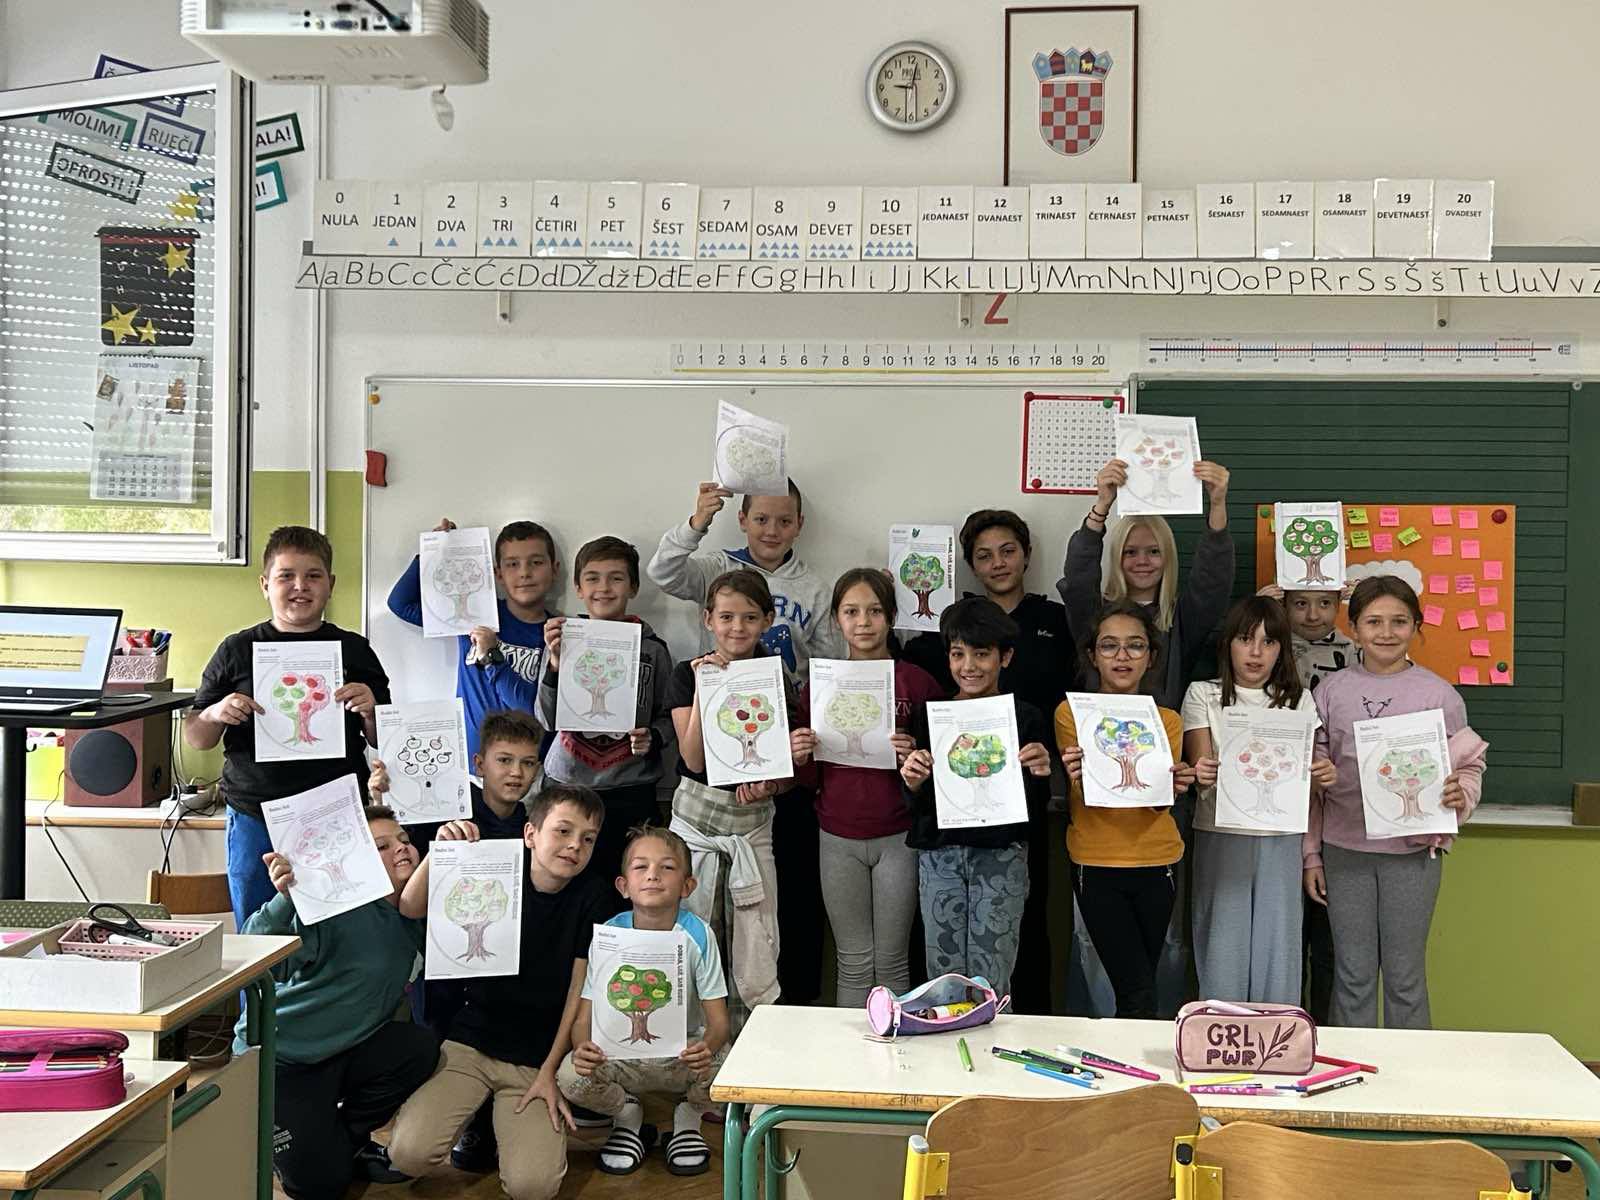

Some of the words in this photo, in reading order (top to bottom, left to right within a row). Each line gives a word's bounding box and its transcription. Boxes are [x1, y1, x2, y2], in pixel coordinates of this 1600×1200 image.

[895, 60, 901, 68] 11
[908, 56, 916, 64] 12
[925, 60, 928, 68] 1
[884, 71, 893, 79] 10
[935, 70, 939, 78] 2
[939, 83, 943, 91] 3
[883, 99, 888, 107] 8
[896, 108, 900, 116] 7
[909, 112, 914, 120] 6
[58, 109, 122, 140] MOLIM!
[256, 126, 292, 147] ALA!
[336, 192, 344, 203] 0
[394, 194, 400, 205] 1
[447, 196, 455, 208] 2
[500, 196, 508, 208] 3
[550, 195, 560, 208] 4
[608, 197, 615, 209] 5
[940, 198, 952, 206] 11
[1050, 196, 1062, 205] 13
[1106, 197, 1118, 205] 14
[1220, 195, 1233, 204] 16
[1280, 194, 1292, 203] 17
[1338, 194, 1351, 203] 18
[1397, 194, 1411, 203] 19
[1458, 194, 1471, 203] 20
[662, 198, 670, 211] 6
[723, 200, 730, 211] 7
[774, 201, 784, 214] 8
[828, 201, 835, 212] 9
[882, 200, 900, 213] 10
[994, 199, 1006, 208] 12
[1161, 200, 1174, 208] 15
[922, 213, 968, 221] JEDANAEST
[1036, 212, 1076, 220] TRINAEST
[1088, 212, 1136, 220] ČETRNAEST
[1208, 210, 1244, 218] ŠESNAEST
[1377, 211, 1429, 219] DEVETNAEST
[322, 214, 359, 226] NULA
[373, 216, 416, 228] JEDAN
[536, 217, 577, 232] ČETIRI
[438, 220, 466, 232] DVA
[493, 220, 512, 232] TRI
[601, 220, 624, 232] PET
[653, 219, 684, 234] ŠEST
[699, 221, 748, 233] SEDAM
[756, 224, 798, 236] OSAM
[810, 224, 852, 236] DEVET
[871, 224, 912, 236] DESET
[677, 355, 684, 366] 0
[698, 355, 703, 365] 1
[718, 355, 725, 365] 2
[738, 355, 746, 365] 3
[759, 355, 766, 365] 4
[780, 355, 787, 366] 5
[801, 355, 808, 366] 6
[822, 355, 828, 366] 7
[842, 356, 849, 366] 8
[863, 356, 870, 366] 9
[882, 356, 894, 366] 10
[903, 356, 913, 366] 11
[923, 356, 935, 366] 12
[945, 356, 956, 366] 13
[966, 356, 977, 366] 14
[987, 356, 998, 366] 15
[1008, 356, 1020, 366] 16
[1029, 356, 1040, 366] 17
[1050, 356, 1062, 366] 18
[1072, 356, 1084, 366] 19
[1092, 356, 1105, 366] 20
[1207, 1023, 1254, 1048] GRL
[1207, 1049, 1256, 1065] PWR
